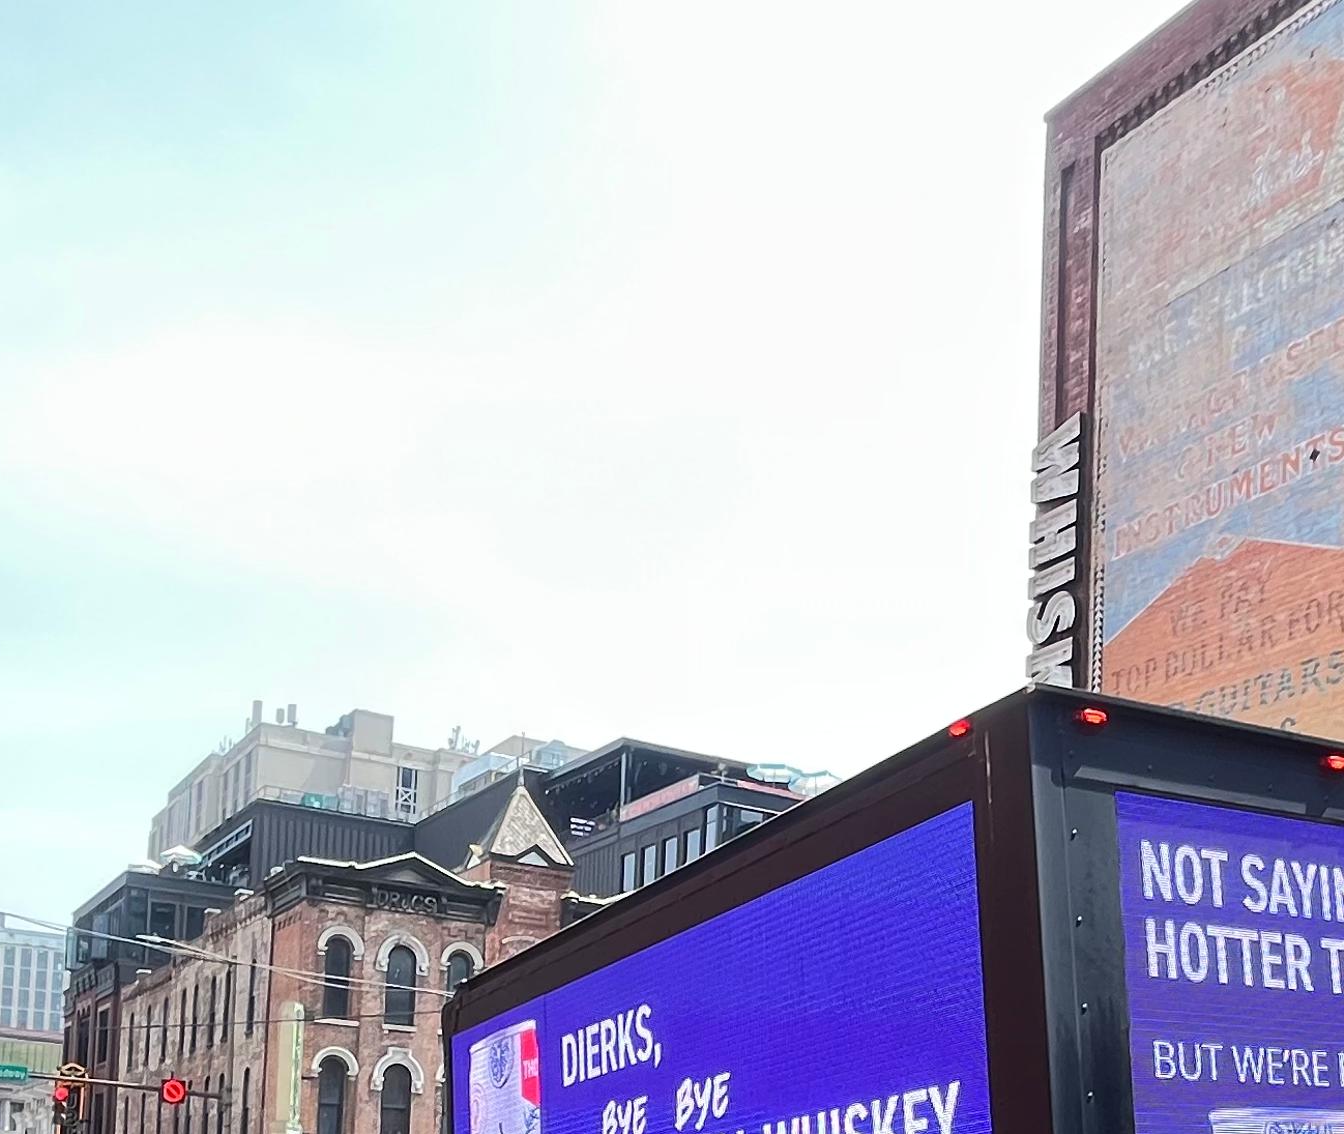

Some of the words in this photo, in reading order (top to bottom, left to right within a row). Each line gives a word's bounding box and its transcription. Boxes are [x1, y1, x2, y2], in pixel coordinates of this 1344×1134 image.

[1112, 658, 1157, 696] TOP
[1140, 839, 1229, 909] NOT
[1144, 915, 1315, 992] HOTTER
[561, 1003, 663, 1088] DIERKS,
[1152, 1040, 1223, 1081] BUT
[1231, 1045, 1330, 1088] WE'RE
[674, 1071, 731, 1132] BYE
